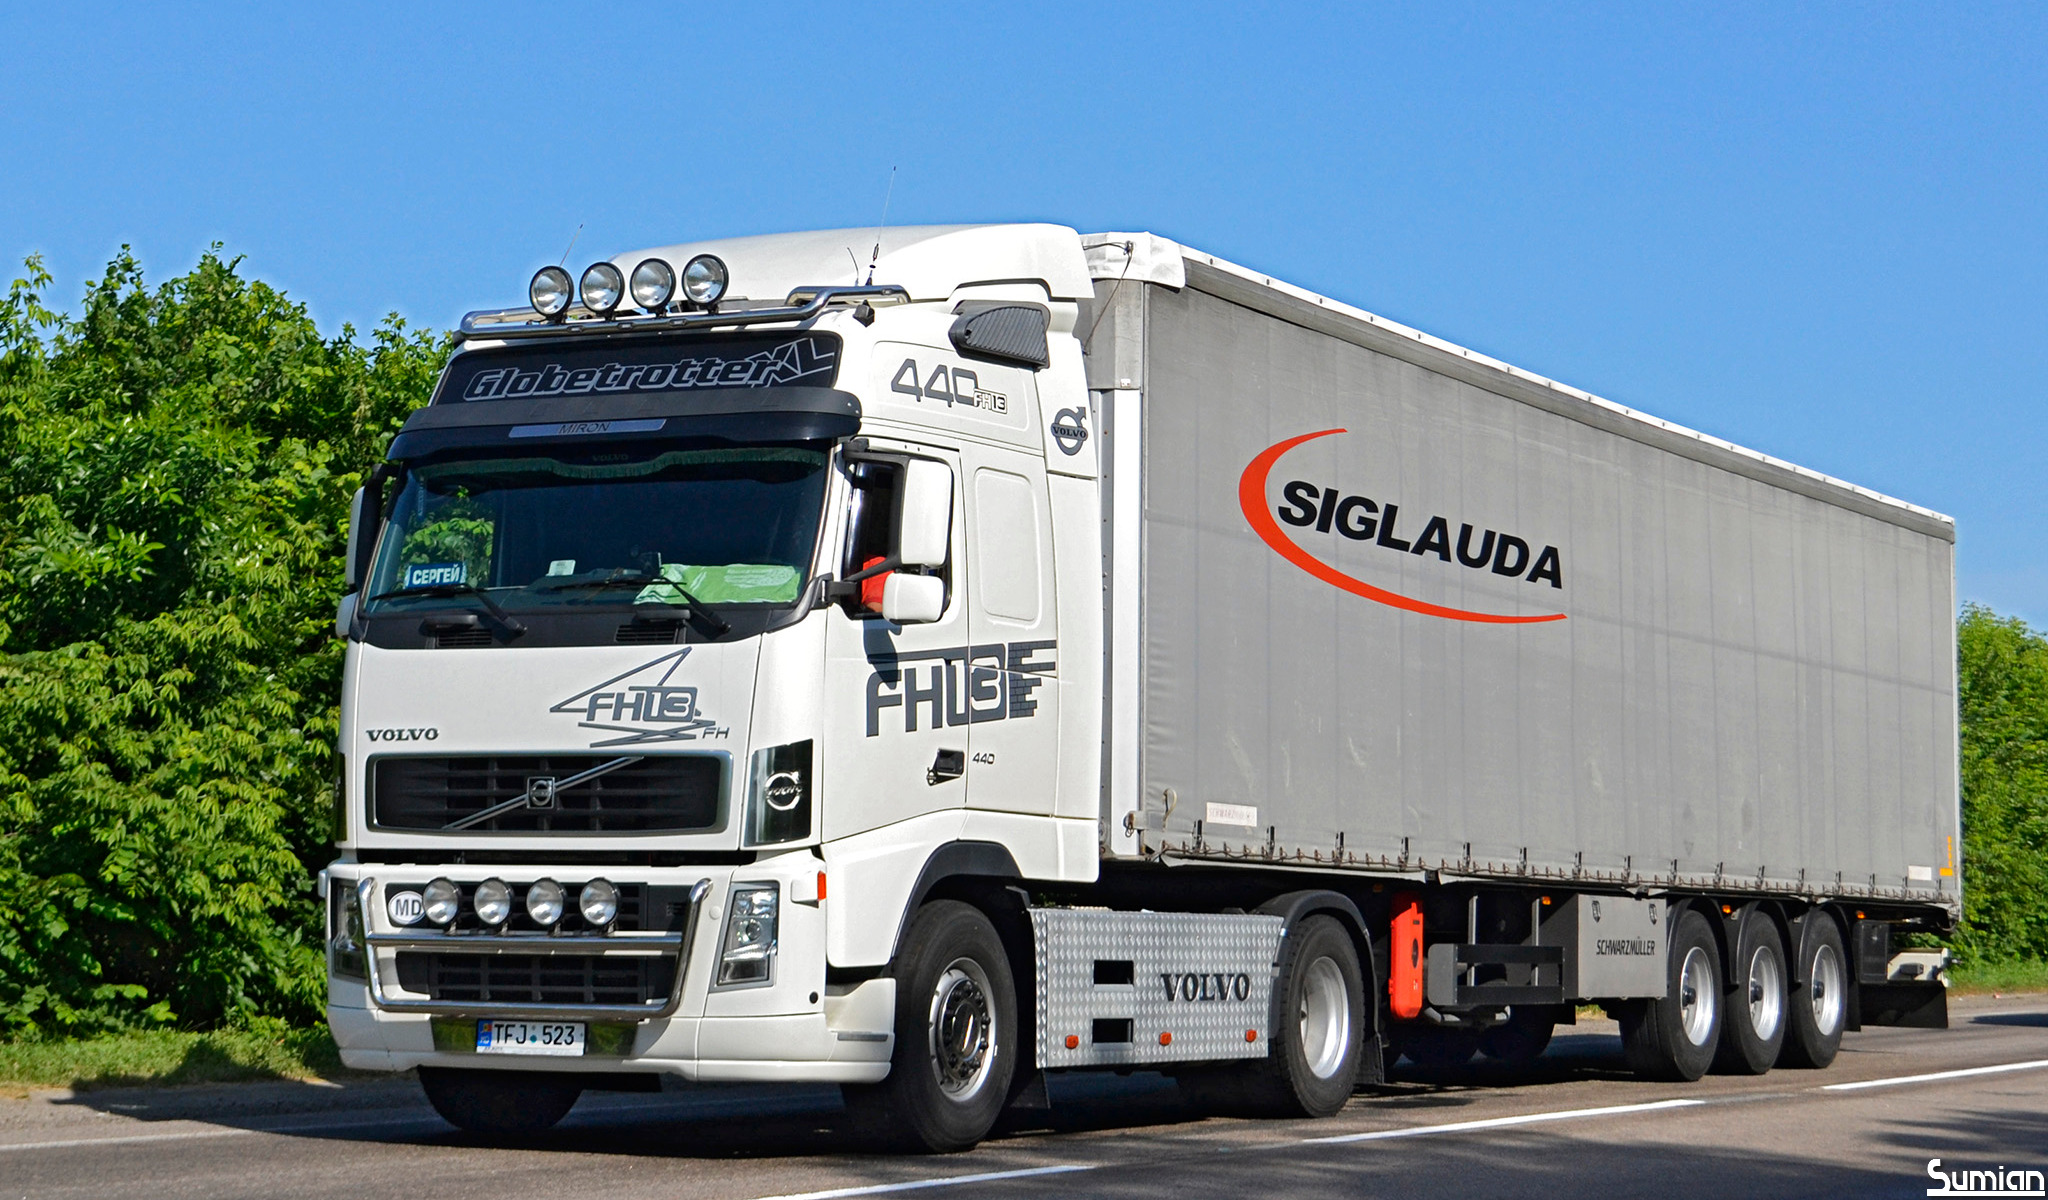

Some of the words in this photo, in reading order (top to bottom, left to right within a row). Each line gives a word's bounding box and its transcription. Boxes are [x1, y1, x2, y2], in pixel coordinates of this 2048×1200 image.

[464, 356, 781, 402] Globetrotter
[891, 358, 978, 408] 440
[974, 388, 1008, 414] FH13
[559, 422, 611, 434] MIRON
[1052, 425, 1087, 439] VOLVO
[1277, 480, 1564, 590] SIGLAUDA
[412, 563, 460, 585] СЕРГЕЙ
[586, 685, 698, 723] FH13
[365, 727, 440, 742] VOLVO
[702, 727, 730, 739] FH
[972, 752, 995, 765] 440
[395, 899, 422, 916] MD
[1596, 935, 1656, 956] SCHWARZMÜLLER
[1160, 972, 1251, 1002] VOLVO
[494, 1023, 528, 1045] TFJ
[542, 1024, 576, 1046] 523
